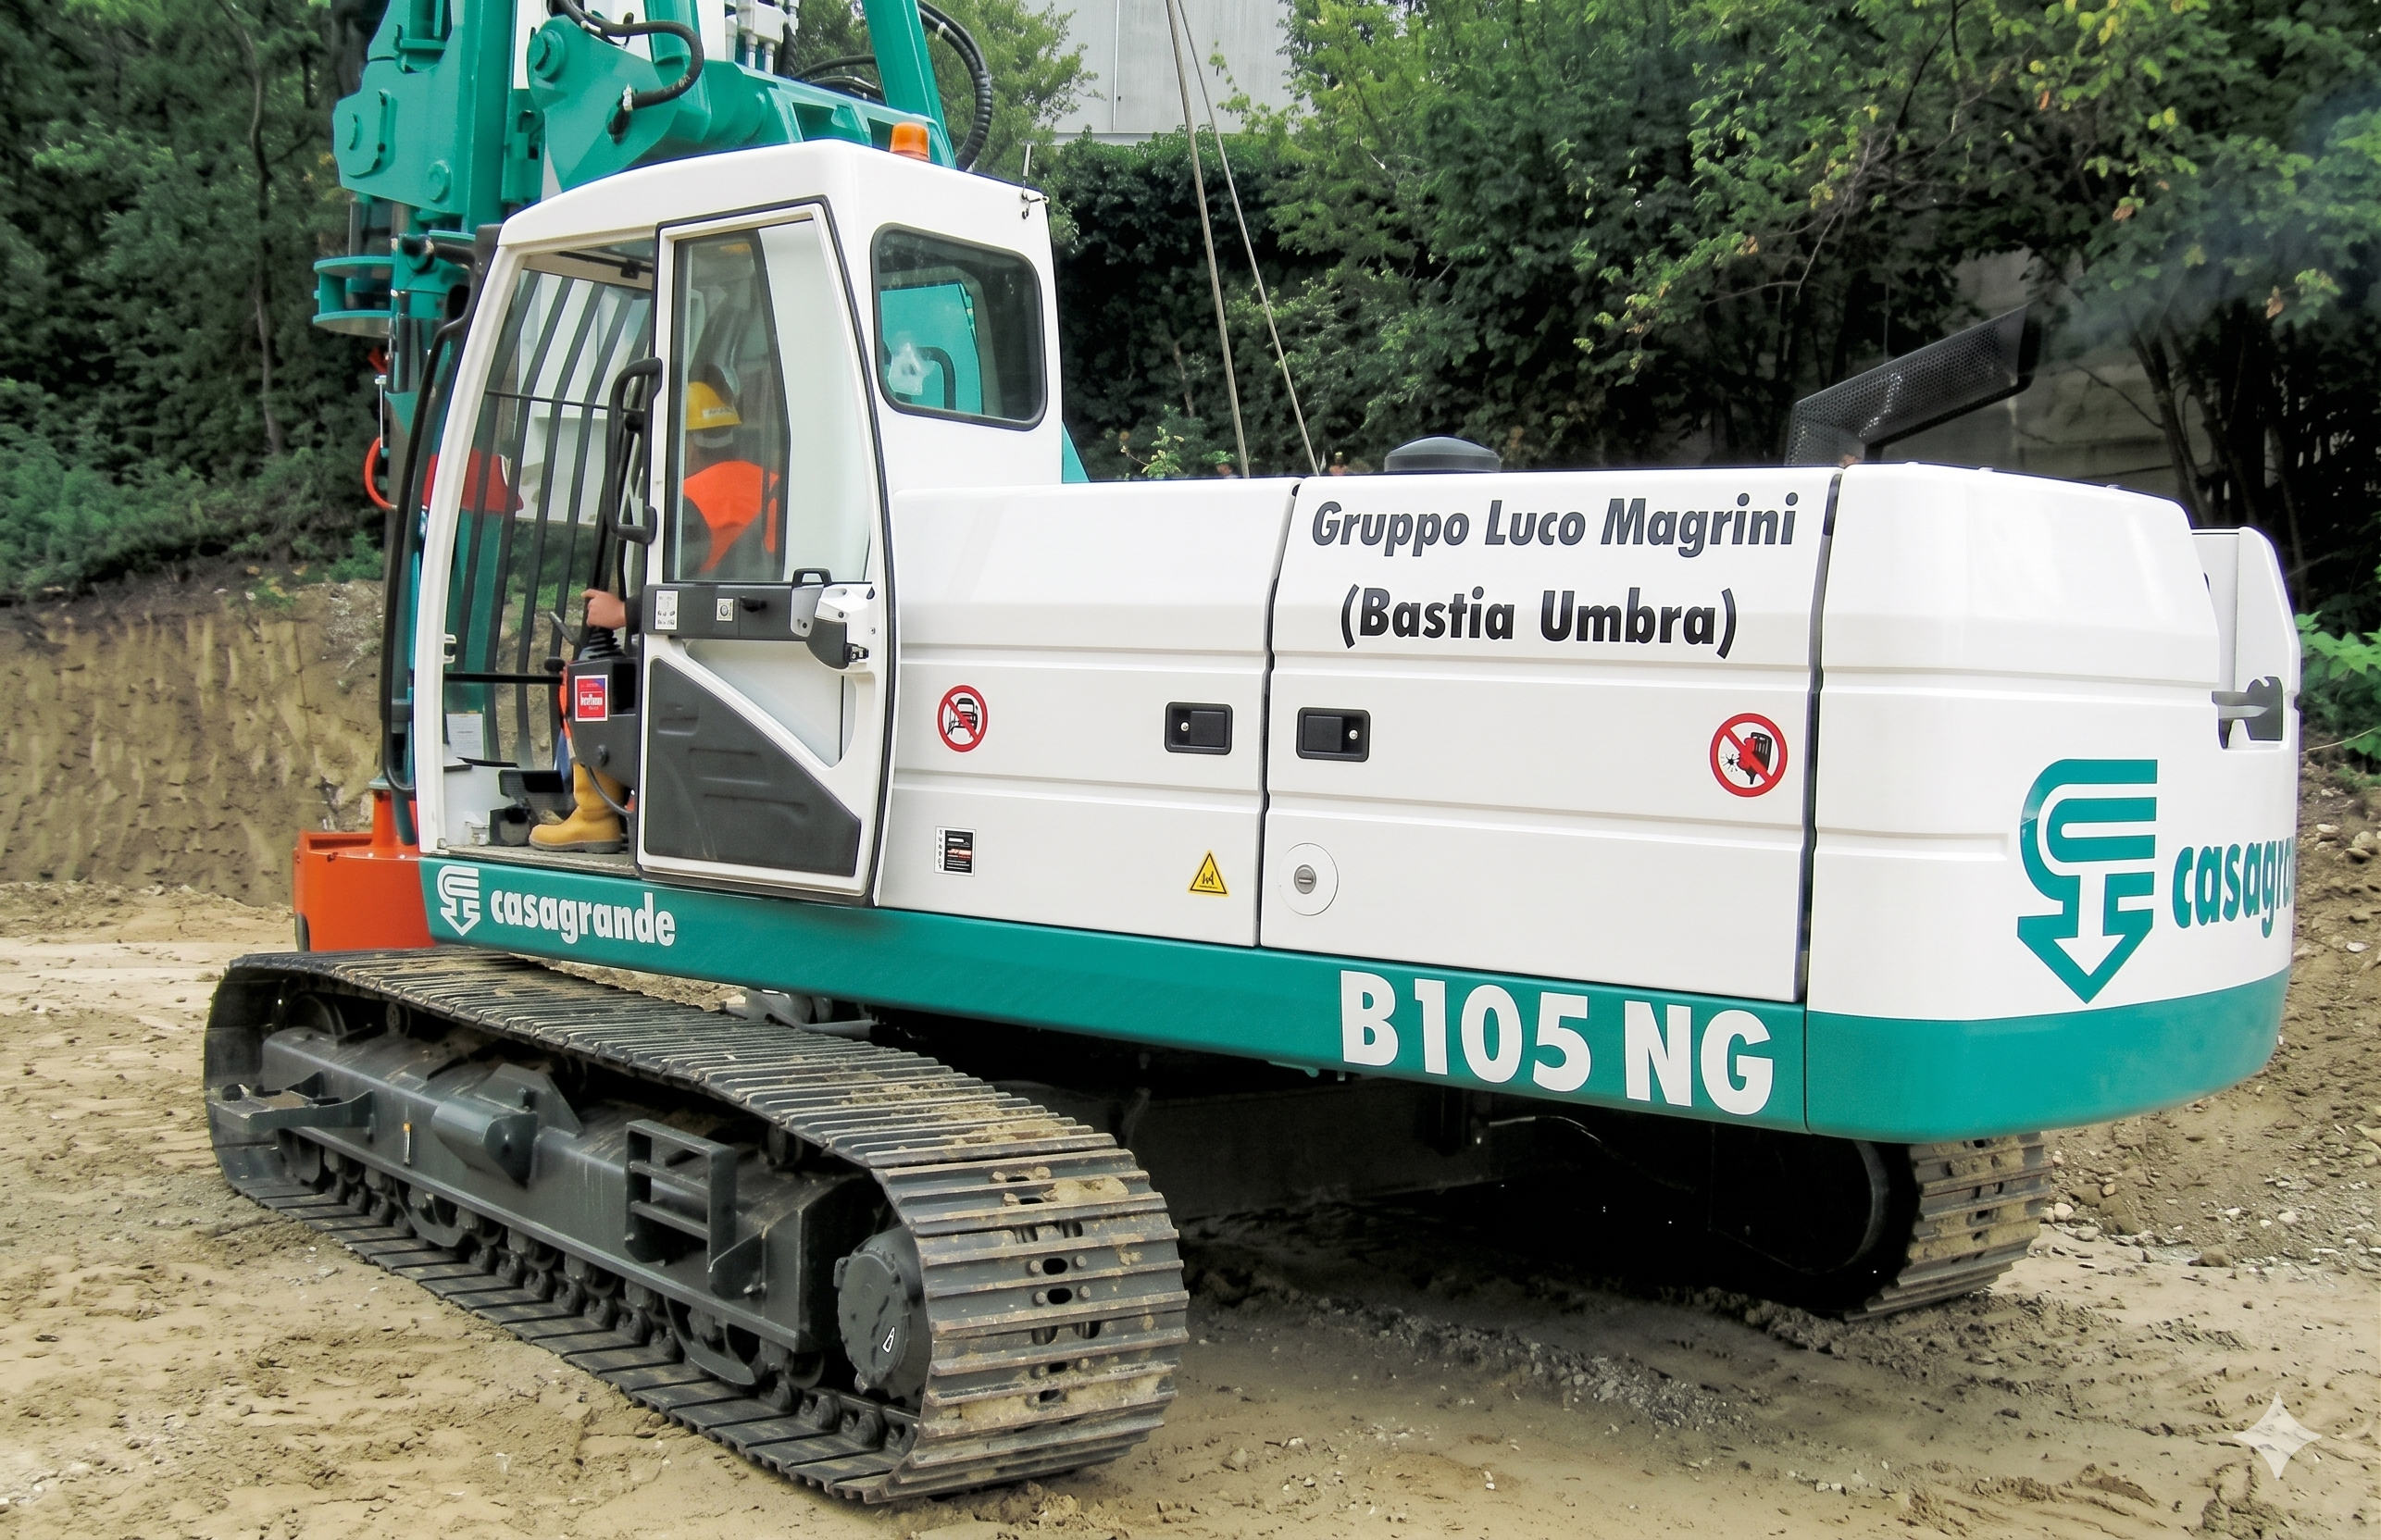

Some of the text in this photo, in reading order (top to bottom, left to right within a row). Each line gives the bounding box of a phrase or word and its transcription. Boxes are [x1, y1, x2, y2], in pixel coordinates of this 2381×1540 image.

[1312, 492, 1799, 557] Gruppo Luco Magrini
[1341, 584, 1737, 659] (Bastia Umbra)
[490, 890, 676, 946] casagrande
[1340, 969, 1774, 1115] B 105 NG
